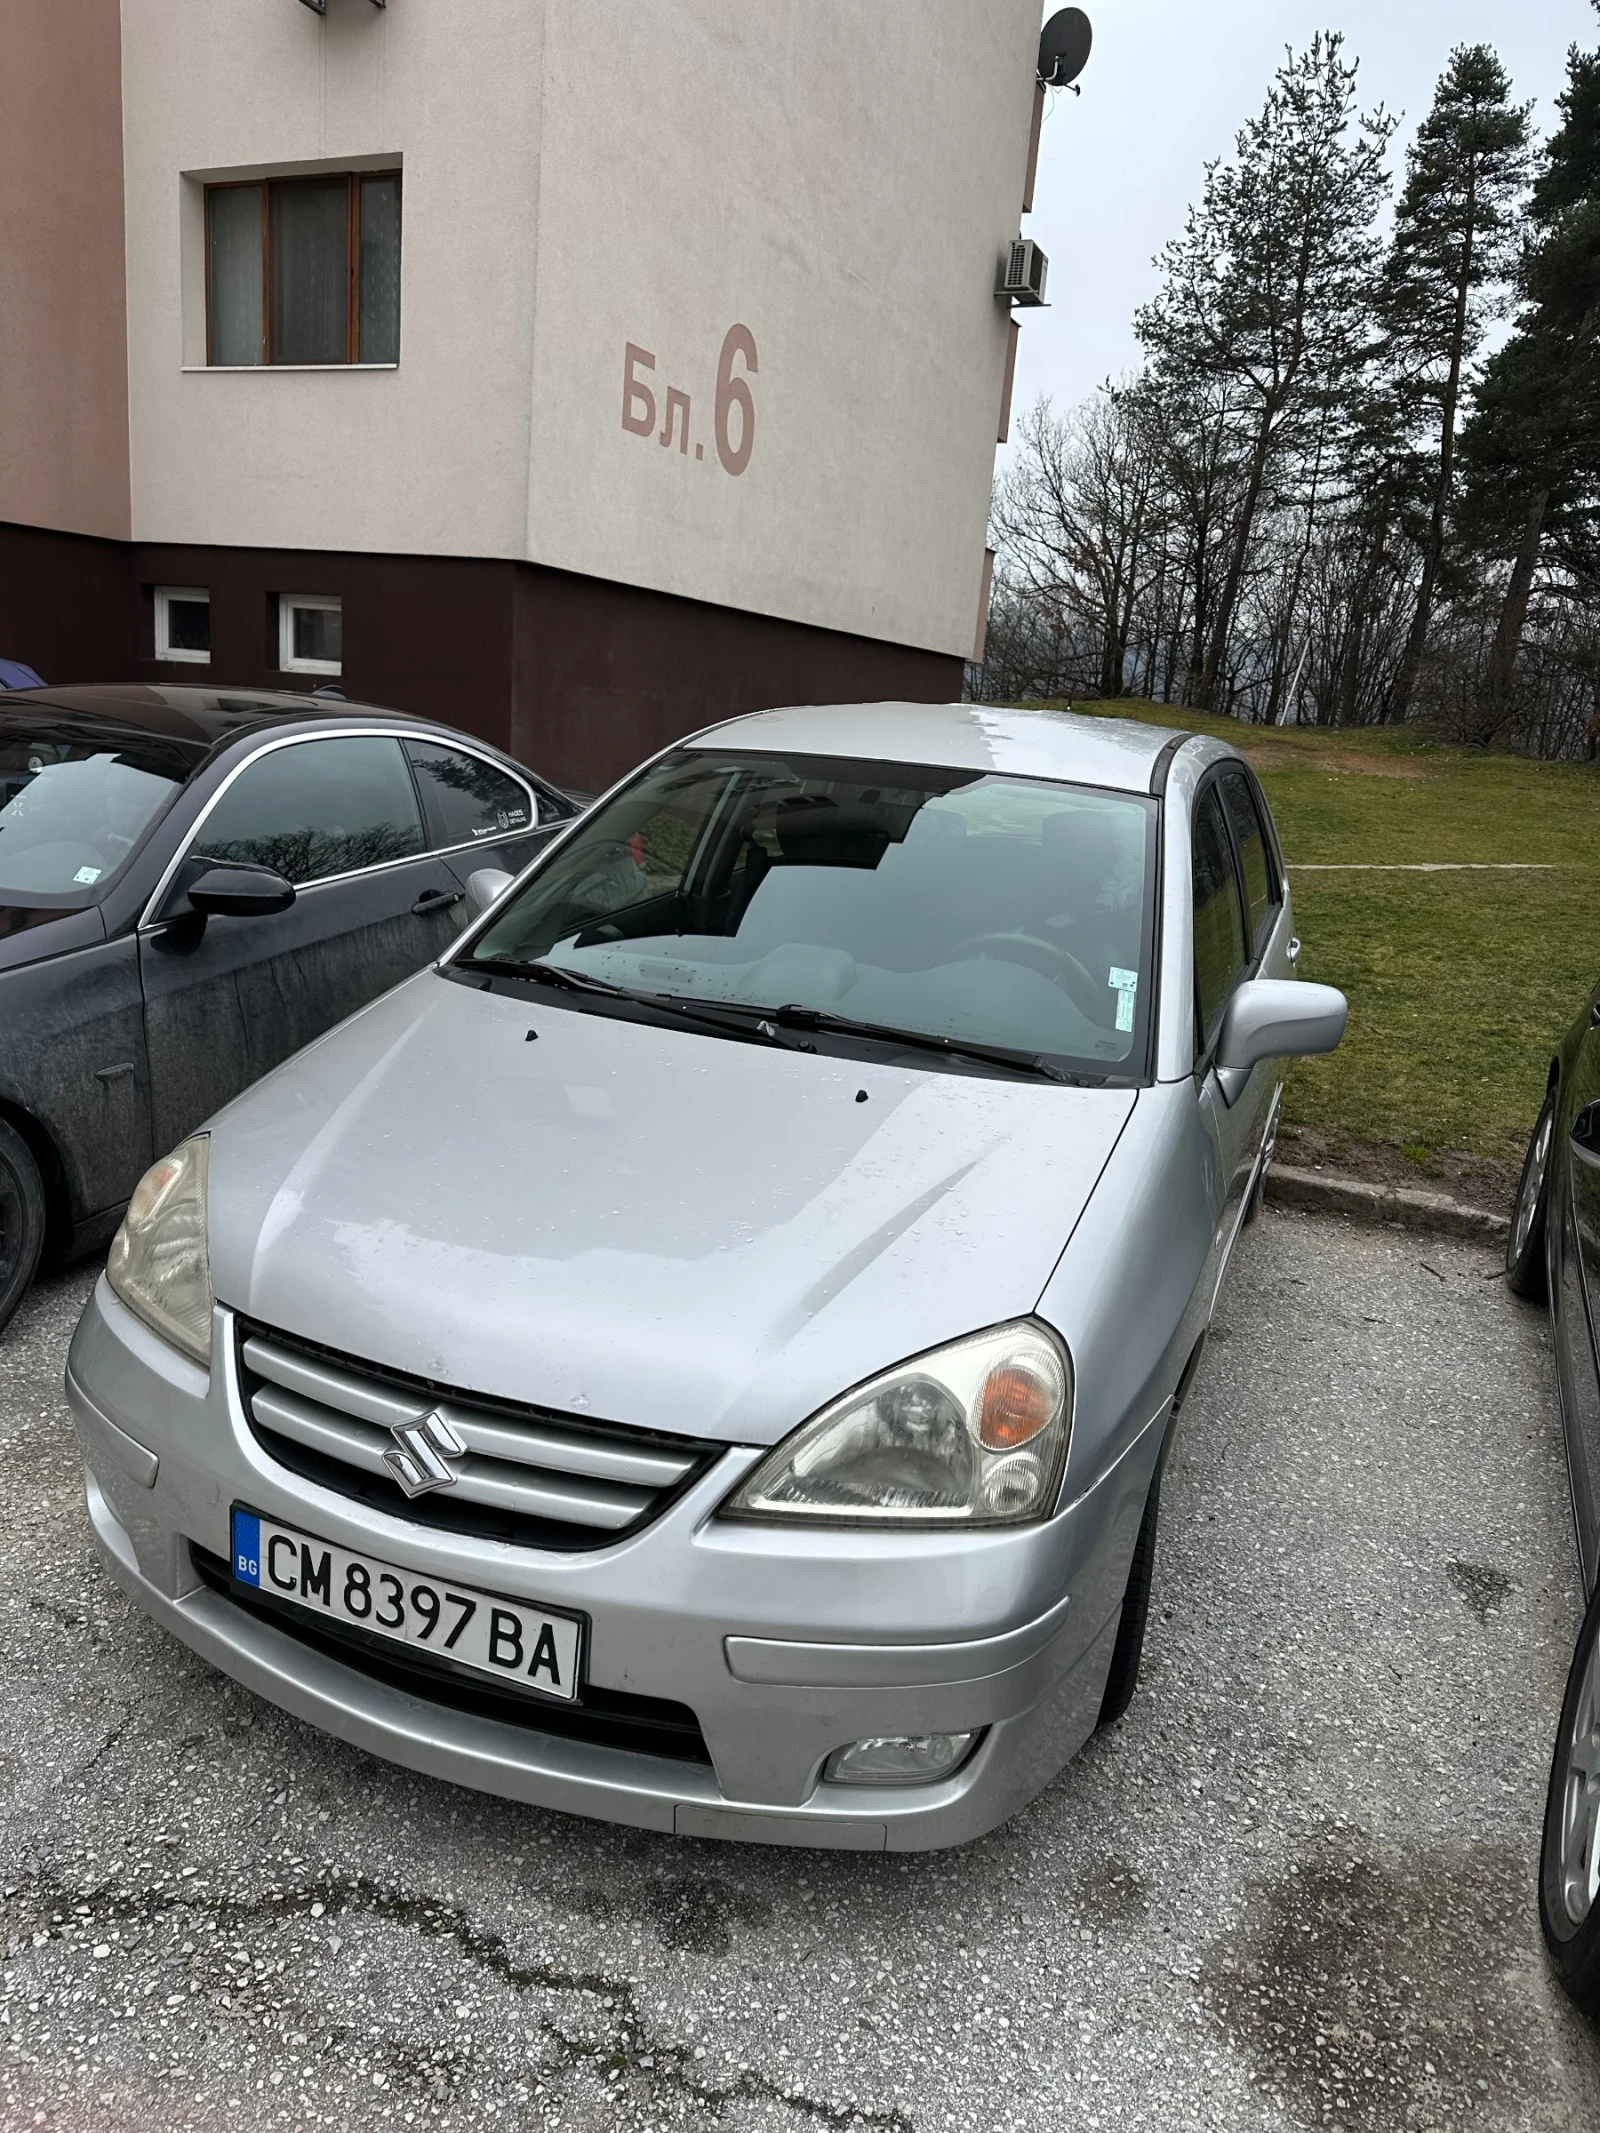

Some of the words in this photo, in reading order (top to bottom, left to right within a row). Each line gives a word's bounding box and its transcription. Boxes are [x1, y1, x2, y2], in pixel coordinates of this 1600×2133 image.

[238, 1554, 258, 1576] BG
[267, 1534, 332, 1607] CM
[343, 1563, 477, 1650] 8397
[488, 1607, 562, 1686] BA
